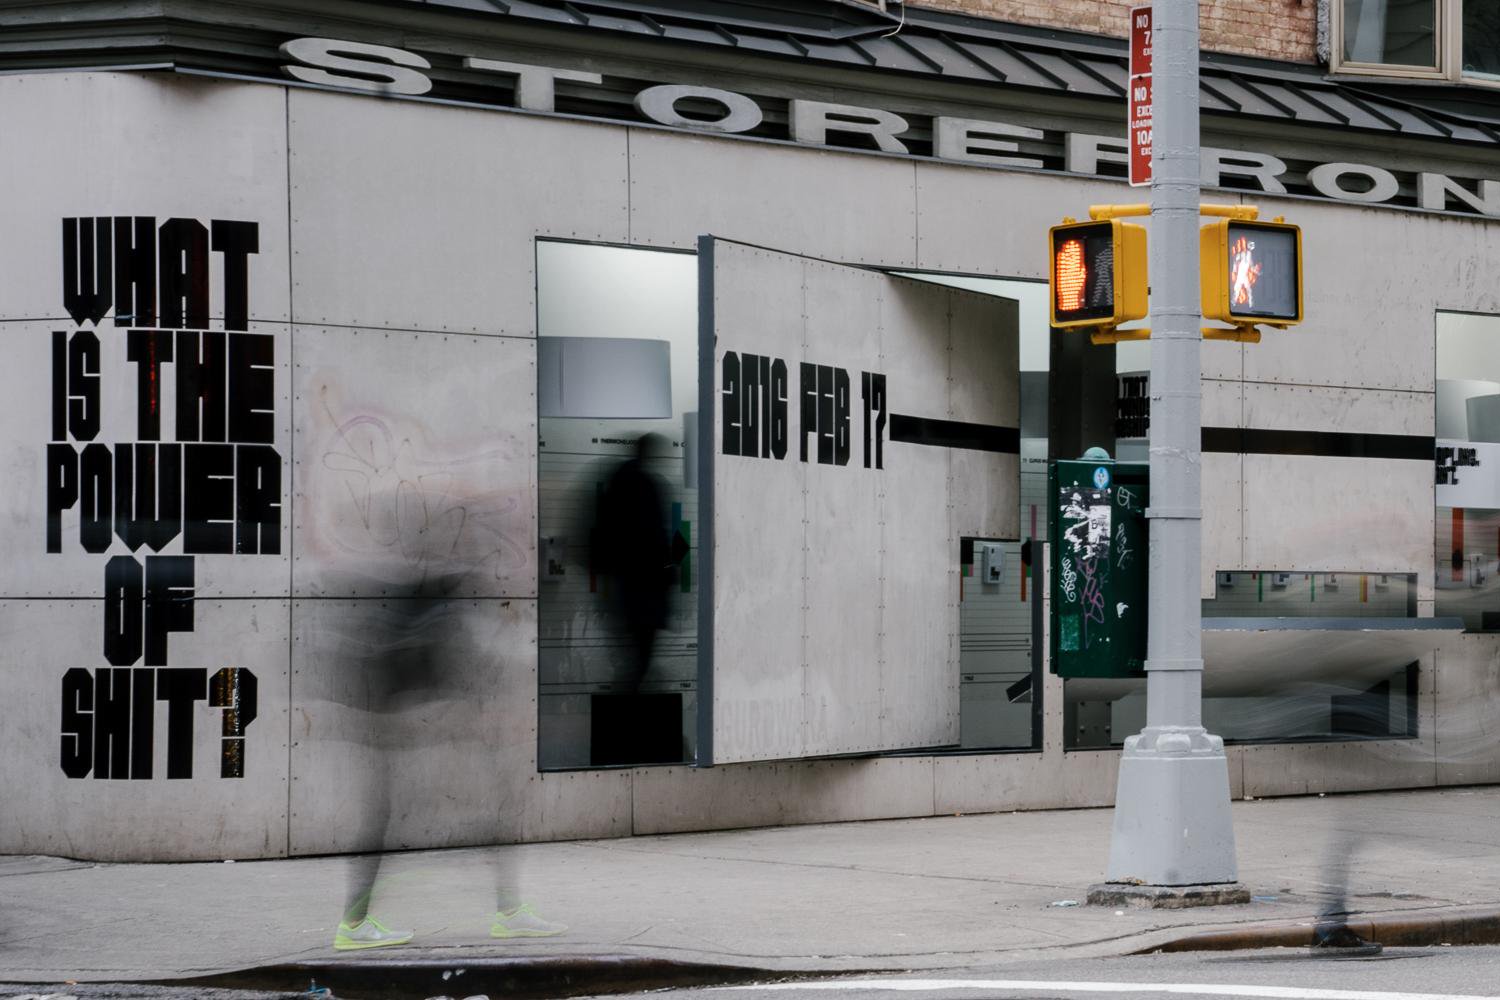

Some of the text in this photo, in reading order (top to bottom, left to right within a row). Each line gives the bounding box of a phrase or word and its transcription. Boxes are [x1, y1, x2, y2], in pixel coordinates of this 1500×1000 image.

[1136, 15, 1149, 28] NO
[1134, 87, 1147, 102] NO
[62, 216, 259, 331] WHAT
[52, 330, 274, 444] IS THE
[722, 350, 887, 470] 2016 FEB 17
[46, 443, 282, 555] POWER
[103, 555, 195, 667] OF
[60, 667, 258, 780] SHIT?
